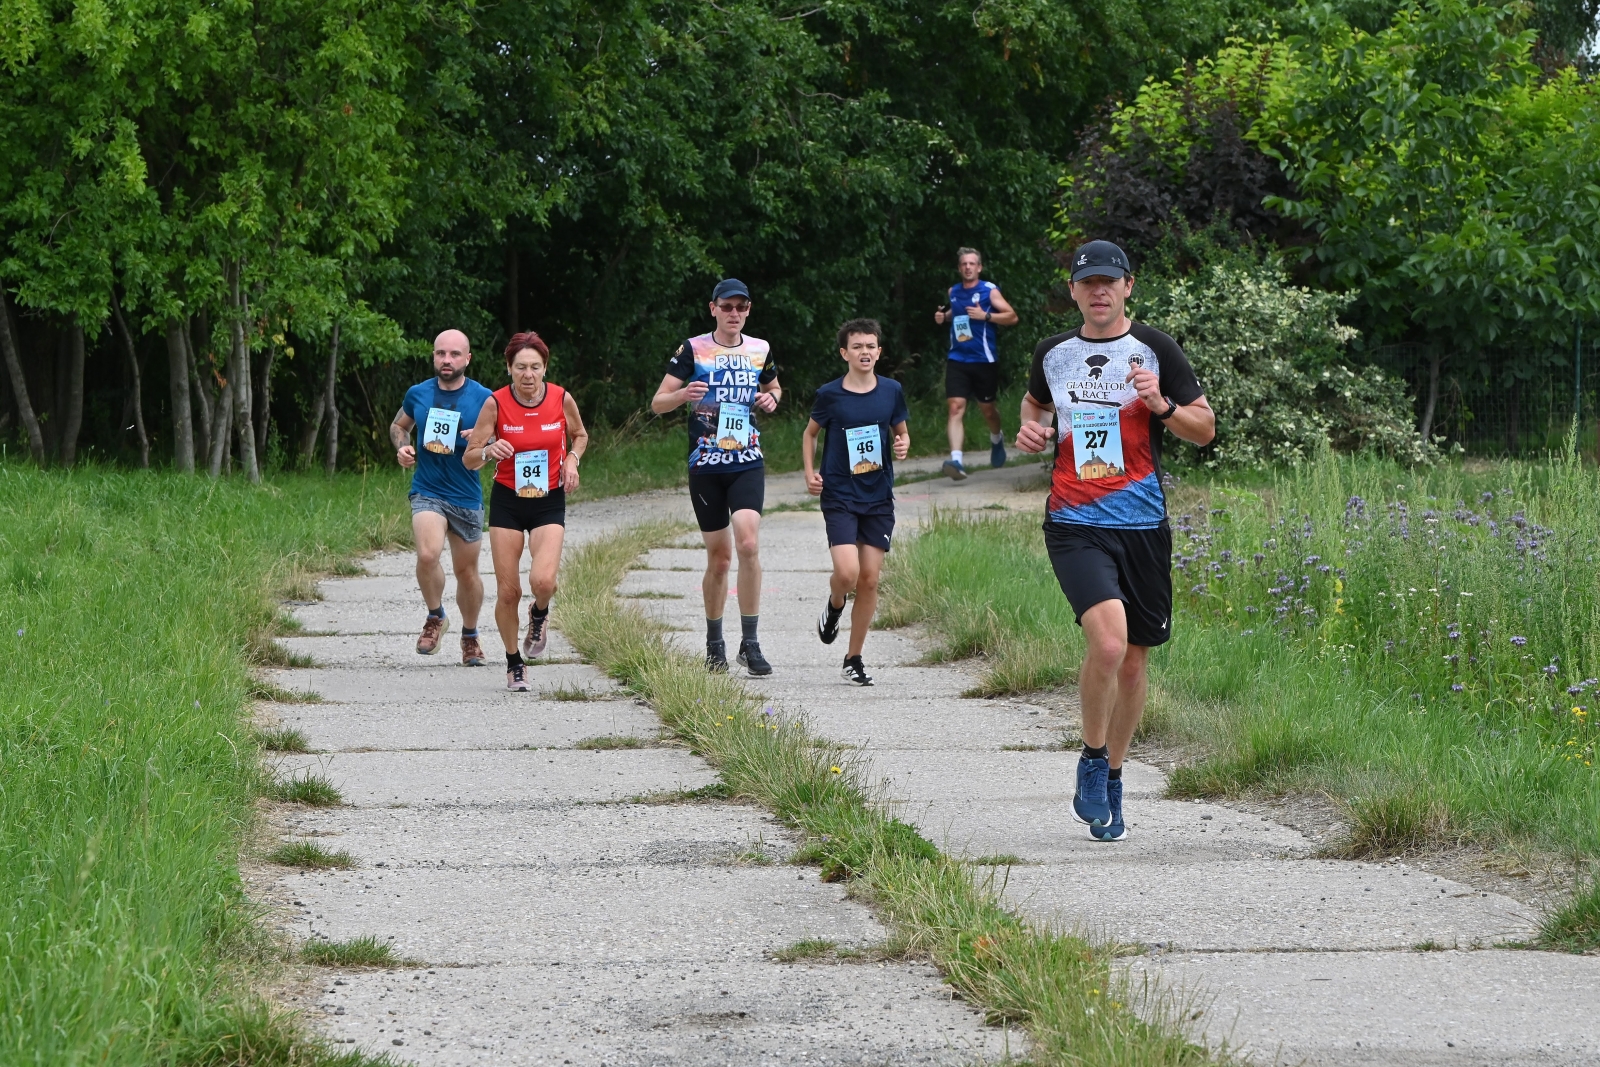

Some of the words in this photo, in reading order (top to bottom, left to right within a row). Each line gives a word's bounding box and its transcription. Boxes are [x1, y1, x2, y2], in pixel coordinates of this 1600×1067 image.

[715, 355, 752, 370] RUN
[708, 370, 757, 387] LABE
[1066, 381, 1126, 391] GLADIATOR
[715, 387, 752, 402] RUN
[1082, 390, 1110, 400] RACE
[433, 421, 450, 435] 39
[725, 417, 743, 430] 116
[1084, 430, 1108, 449] 27
[857, 440, 874, 454] 46
[697, 452, 733, 466] 380
[738, 447, 764, 463] KM
[522, 465, 541, 478] 84
